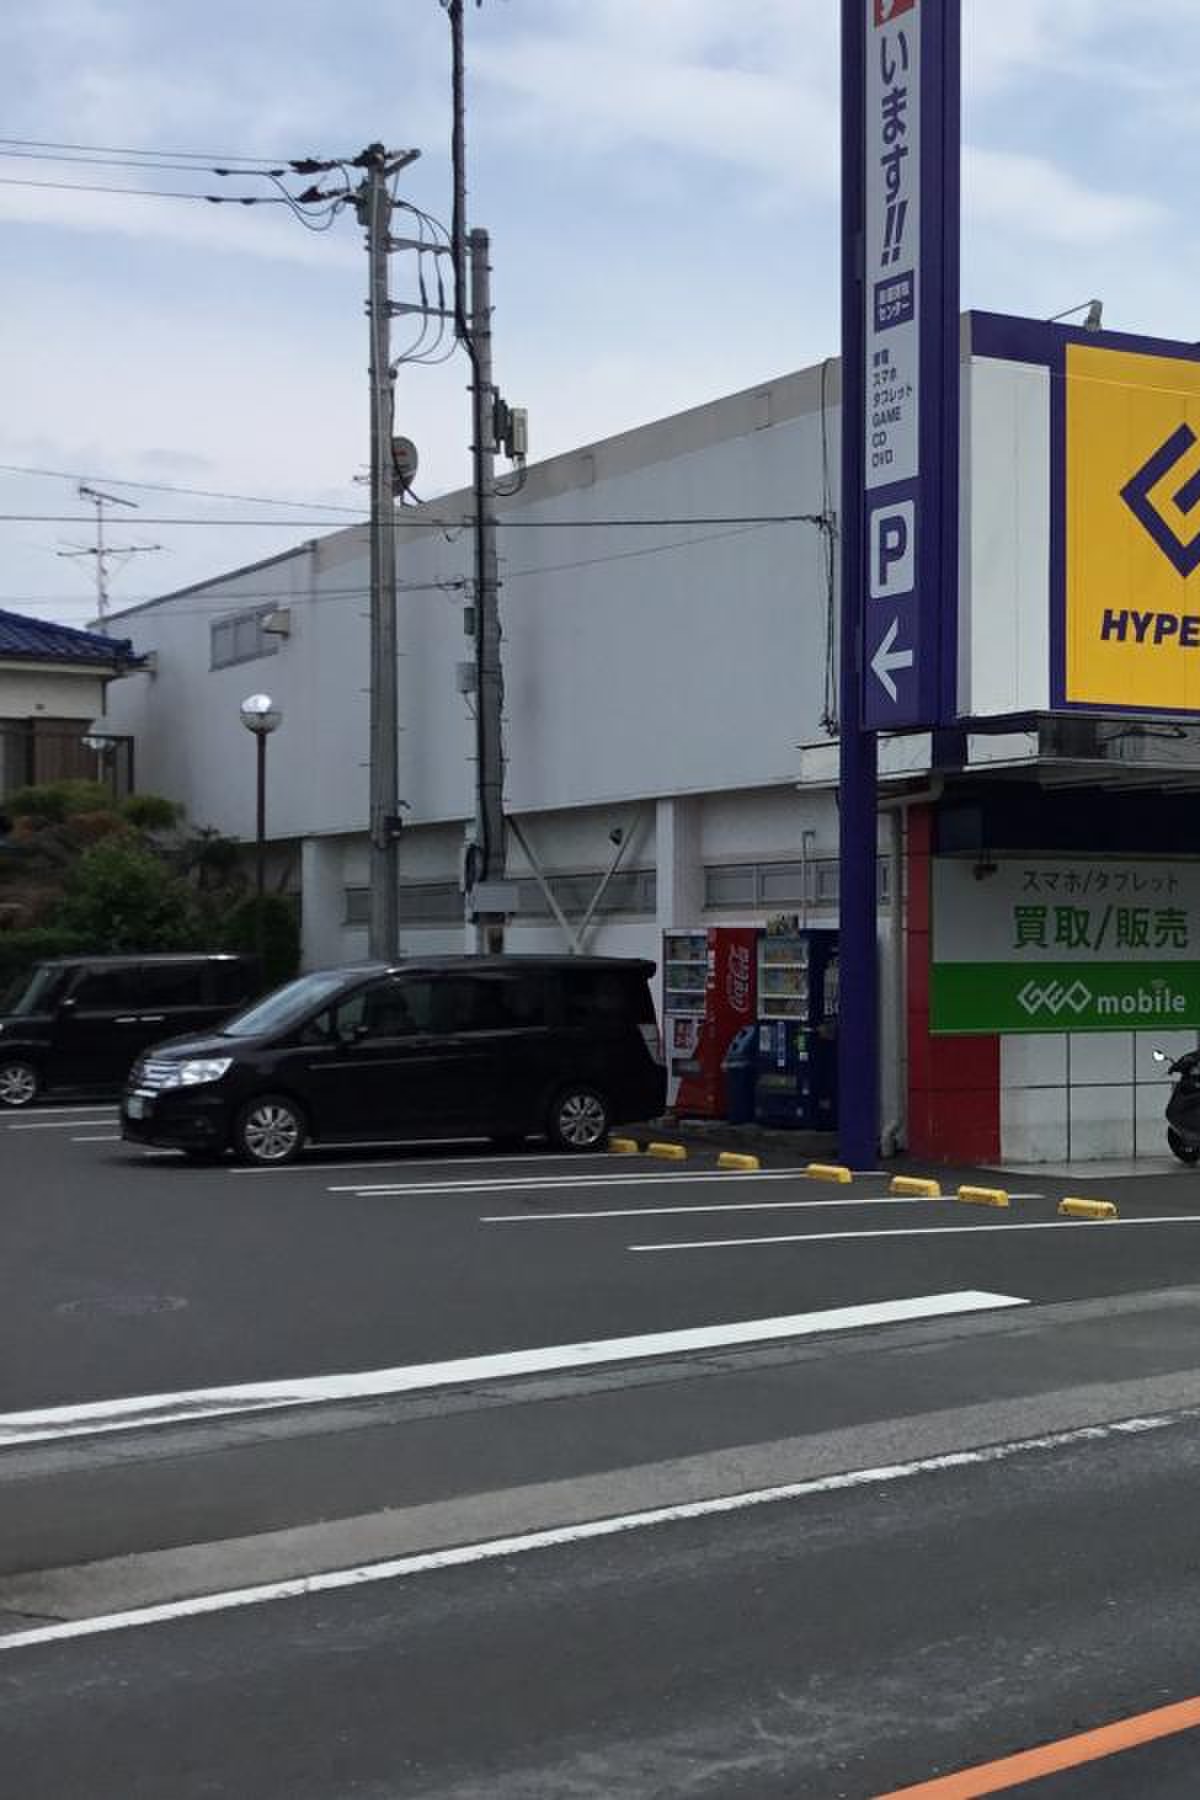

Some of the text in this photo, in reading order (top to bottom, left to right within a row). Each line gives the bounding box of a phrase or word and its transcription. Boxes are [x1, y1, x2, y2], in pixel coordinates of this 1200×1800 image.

[880, 0, 908, 267] います!!
[872, 406, 902, 428] GAME
[872, 431, 887, 449] CD
[879, 513, 907, 585] P
[1013, 903, 1189, 951] 買取/販売
[1097, 982, 1187, 1015] mobile
